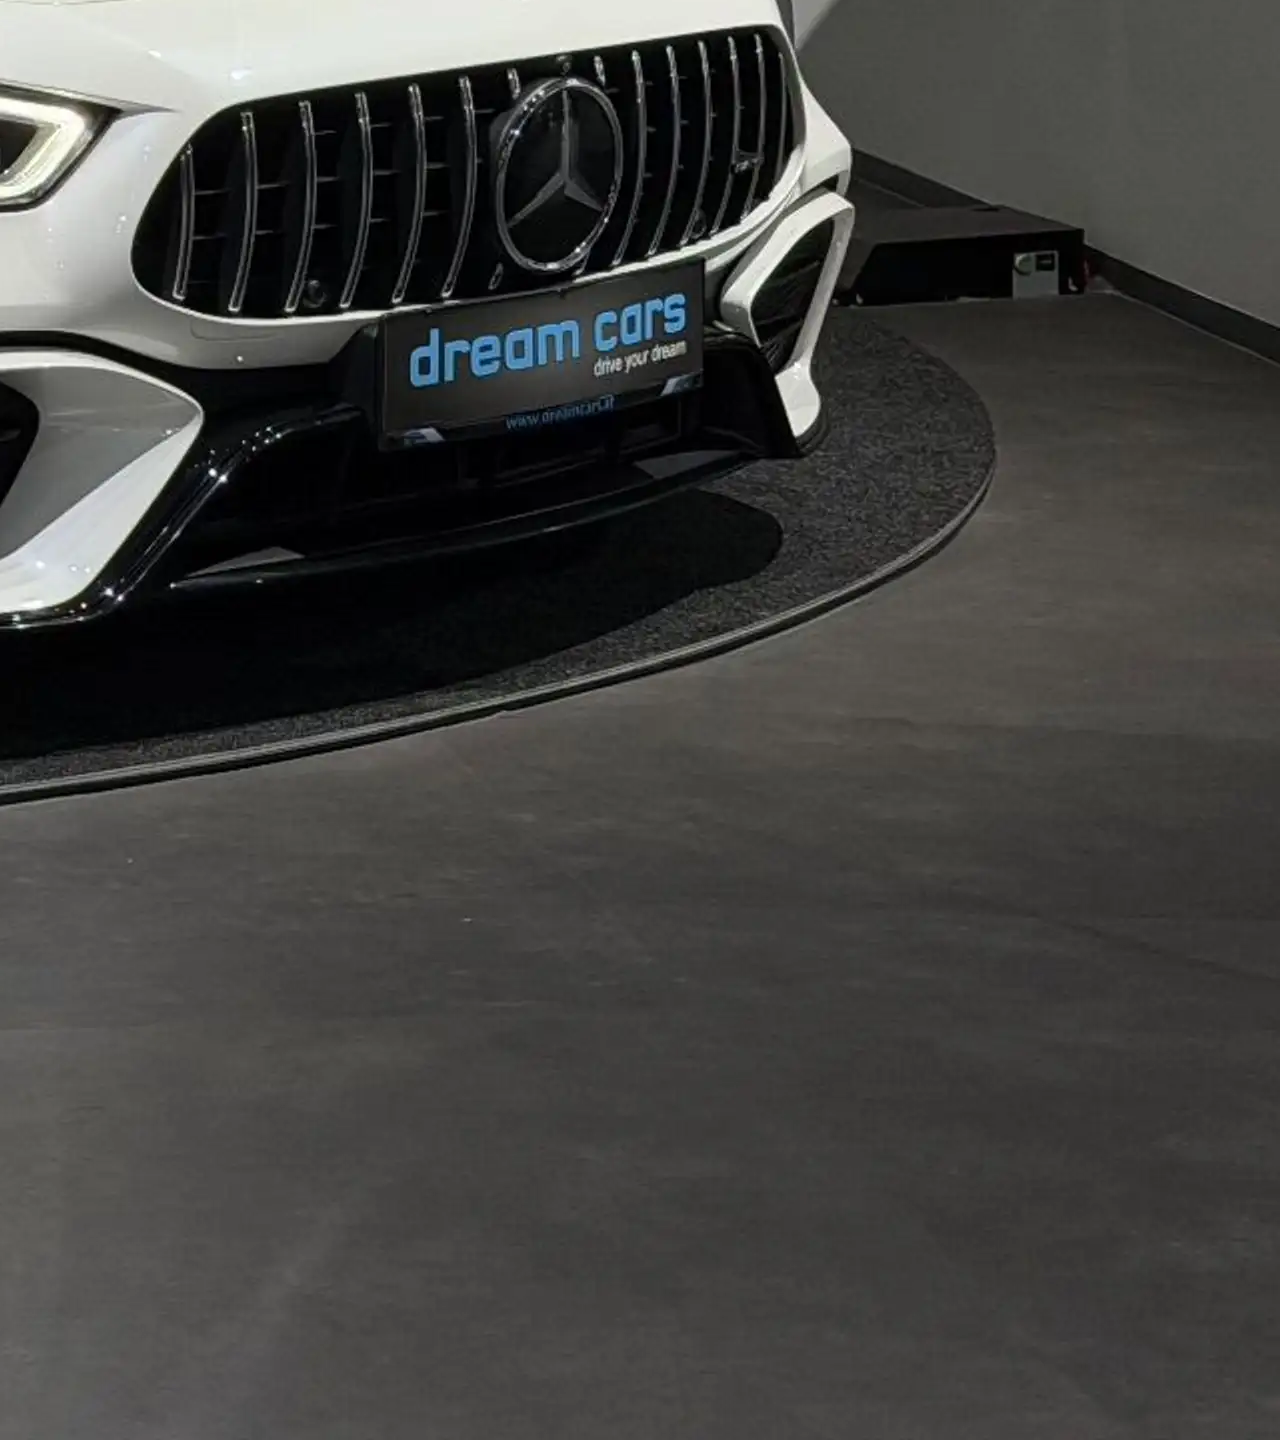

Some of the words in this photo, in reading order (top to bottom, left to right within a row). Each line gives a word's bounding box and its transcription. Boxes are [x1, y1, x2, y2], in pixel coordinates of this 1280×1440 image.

[409, 319, 581, 387] dream
[592, 293, 687, 351] cars
[593, 356, 622, 377] drive
[624, 350, 649, 374] your
[651, 340, 687, 362] dream
